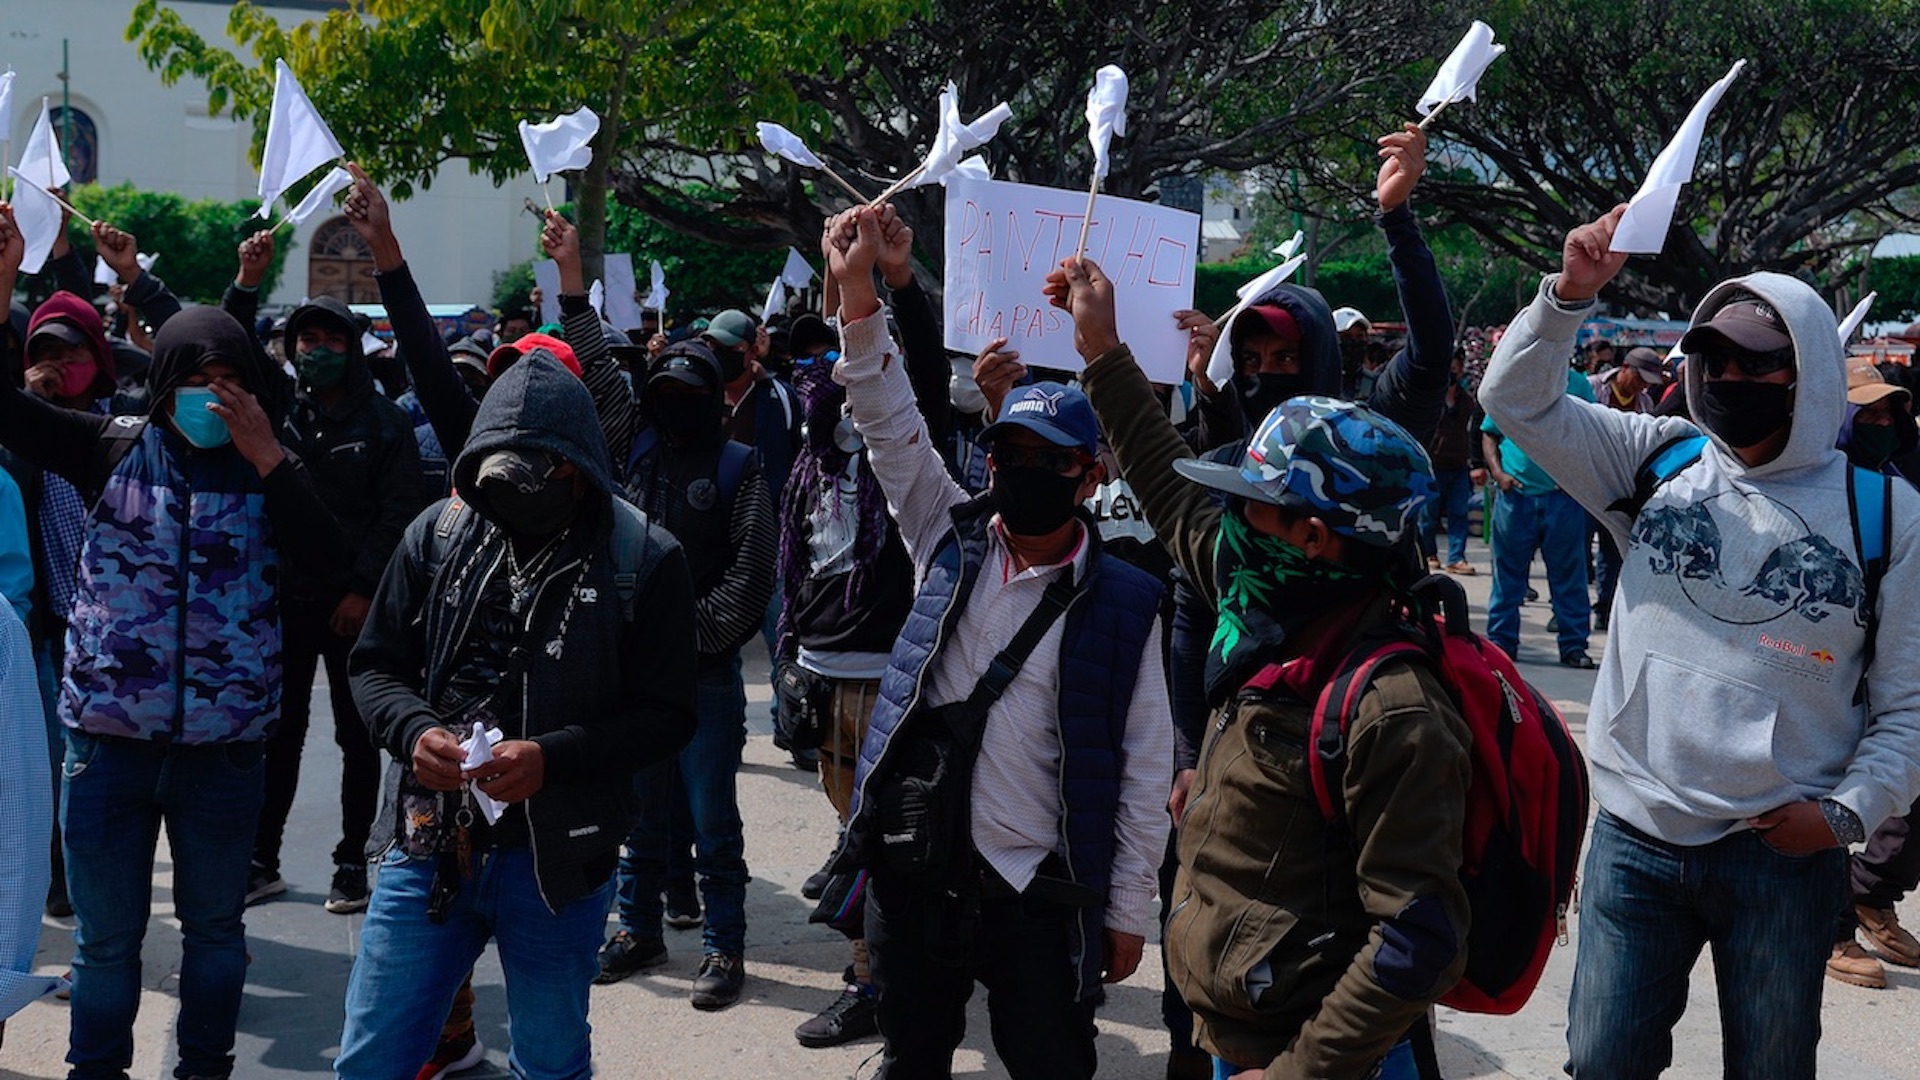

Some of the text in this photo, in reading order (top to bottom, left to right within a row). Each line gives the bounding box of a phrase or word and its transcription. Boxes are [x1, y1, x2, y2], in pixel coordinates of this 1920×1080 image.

[1759, 633, 1806, 656] Red Bull
[1755, 647, 1834, 676] RACING
